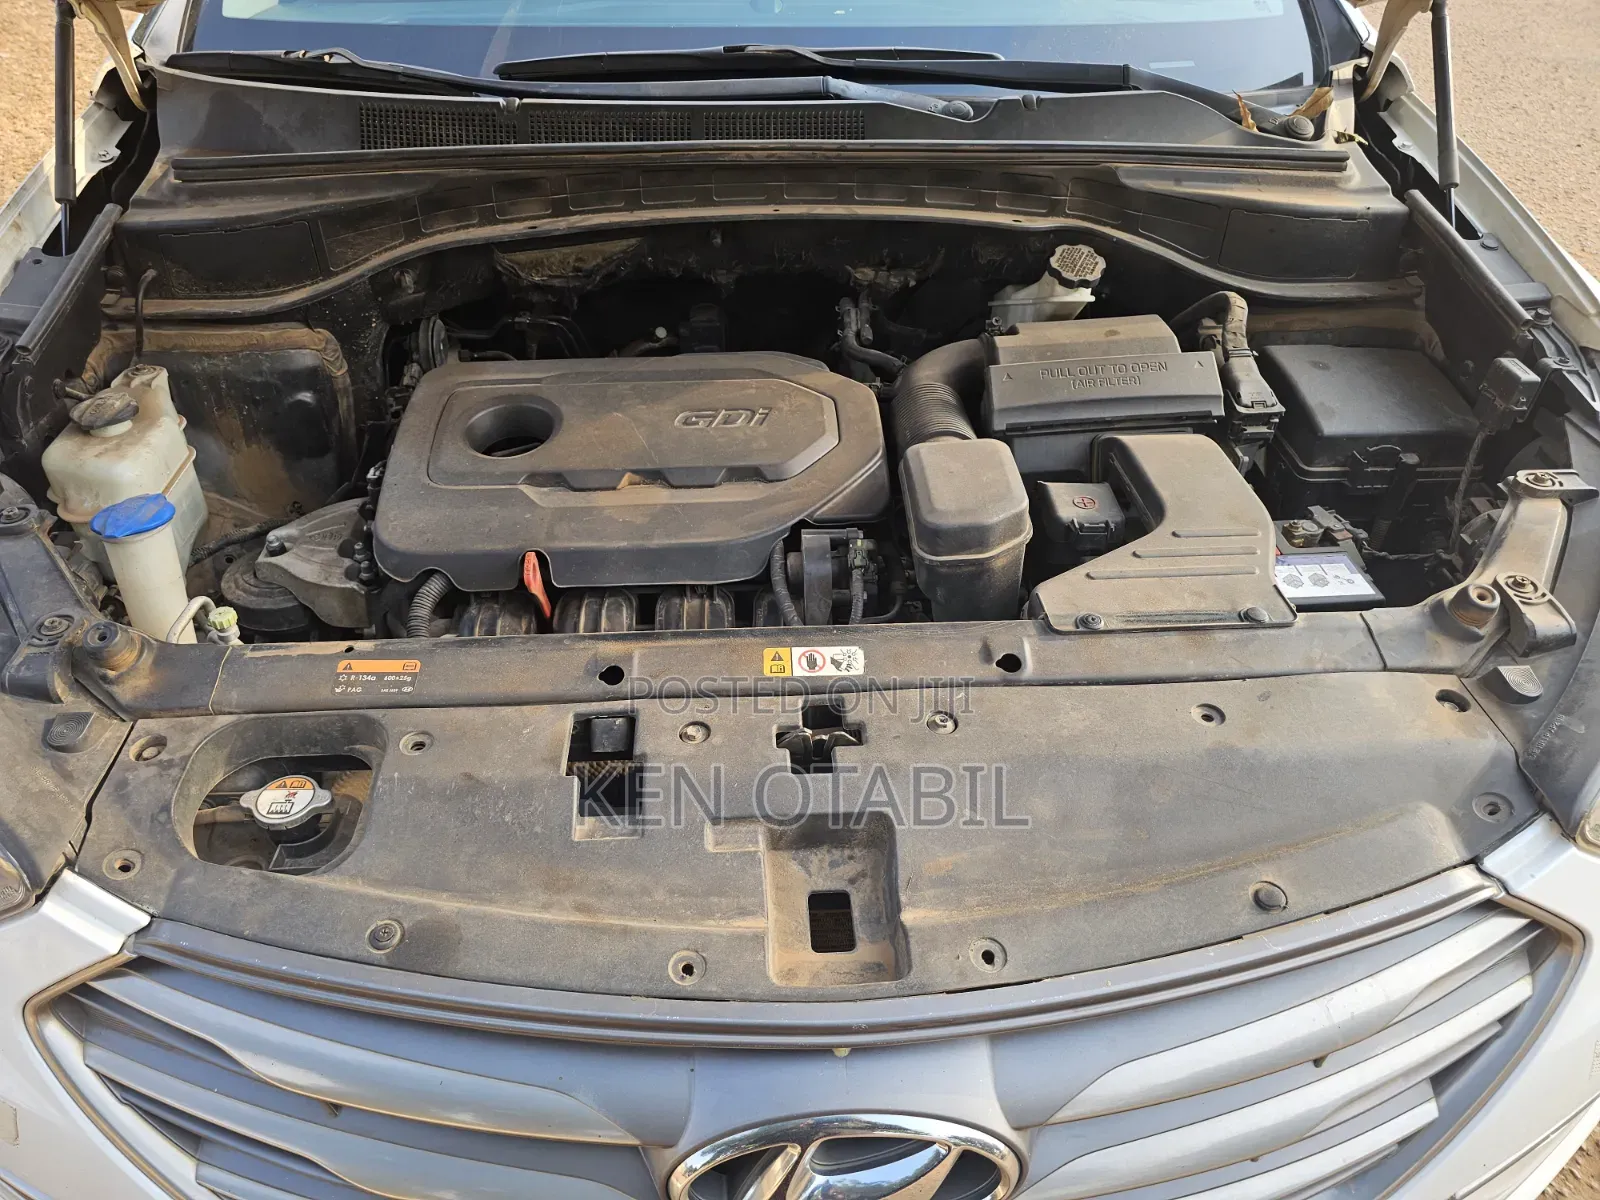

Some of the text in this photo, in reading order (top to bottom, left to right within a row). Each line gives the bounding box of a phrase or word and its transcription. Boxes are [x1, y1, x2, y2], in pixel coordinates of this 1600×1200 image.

[1040, 361, 1168, 379] PULL OUT TO OPEN
[1071, 375, 1142, 390] (AIR FILTER)
[674, 407, 772, 429] GDi
